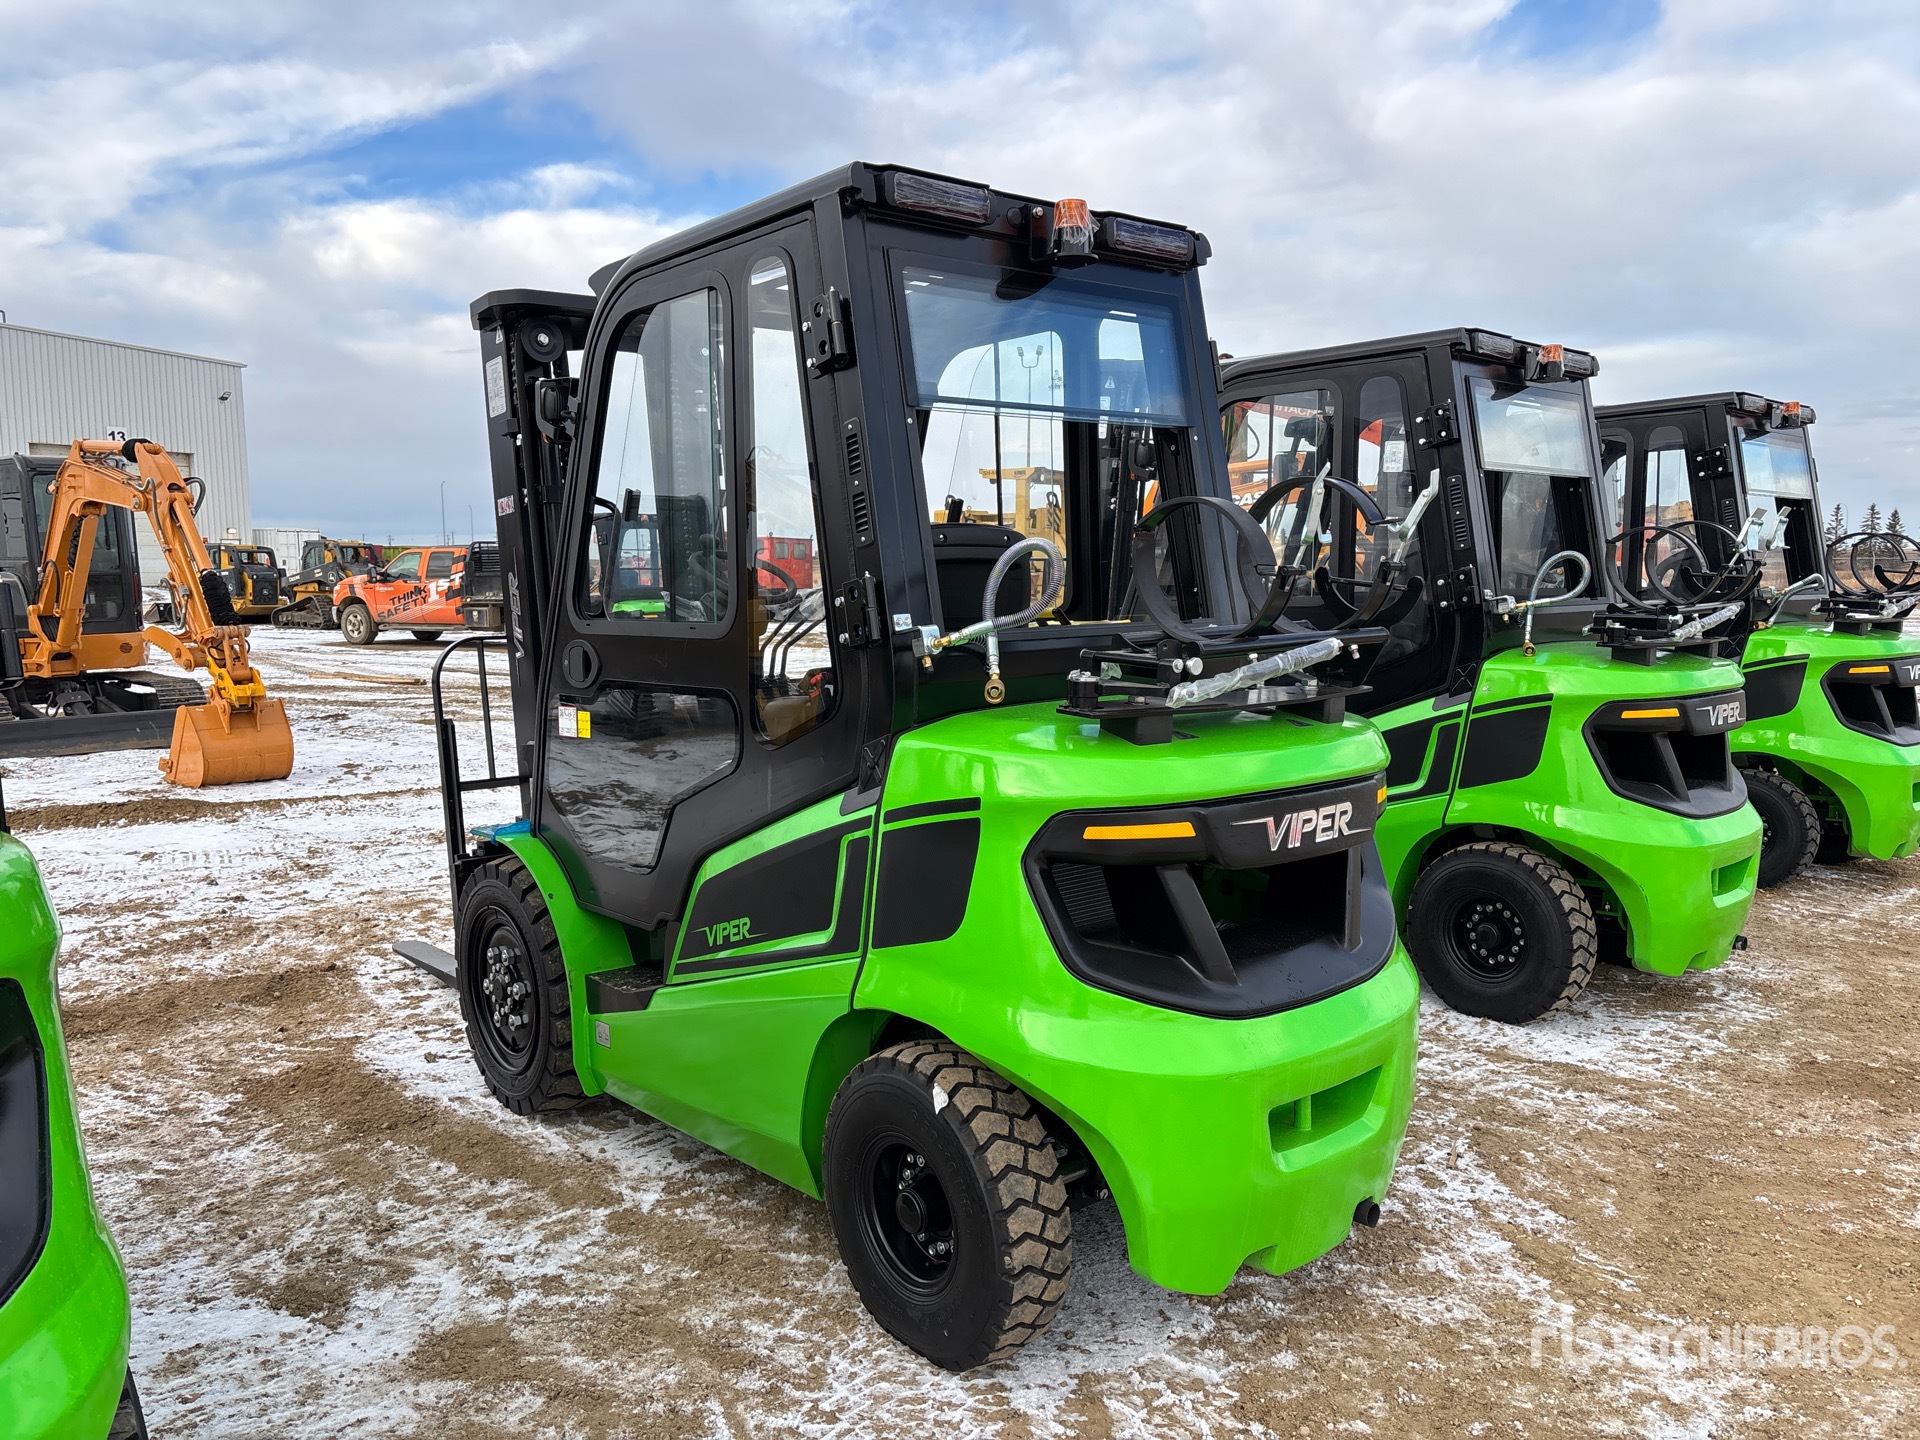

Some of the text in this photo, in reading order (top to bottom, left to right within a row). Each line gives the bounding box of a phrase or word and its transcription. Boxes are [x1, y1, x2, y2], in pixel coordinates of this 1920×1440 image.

[108, 431, 126, 441] 13
[1232, 490, 1266, 506] CAS
[389, 585, 428, 605] THINK
[377, 595, 429, 623] SAFETY
[508, 550, 525, 685] VIPER
[1696, 702, 1746, 727] VIPER
[1231, 801, 1371, 851] VIPER
[691, 916, 768, 947] VIPER
